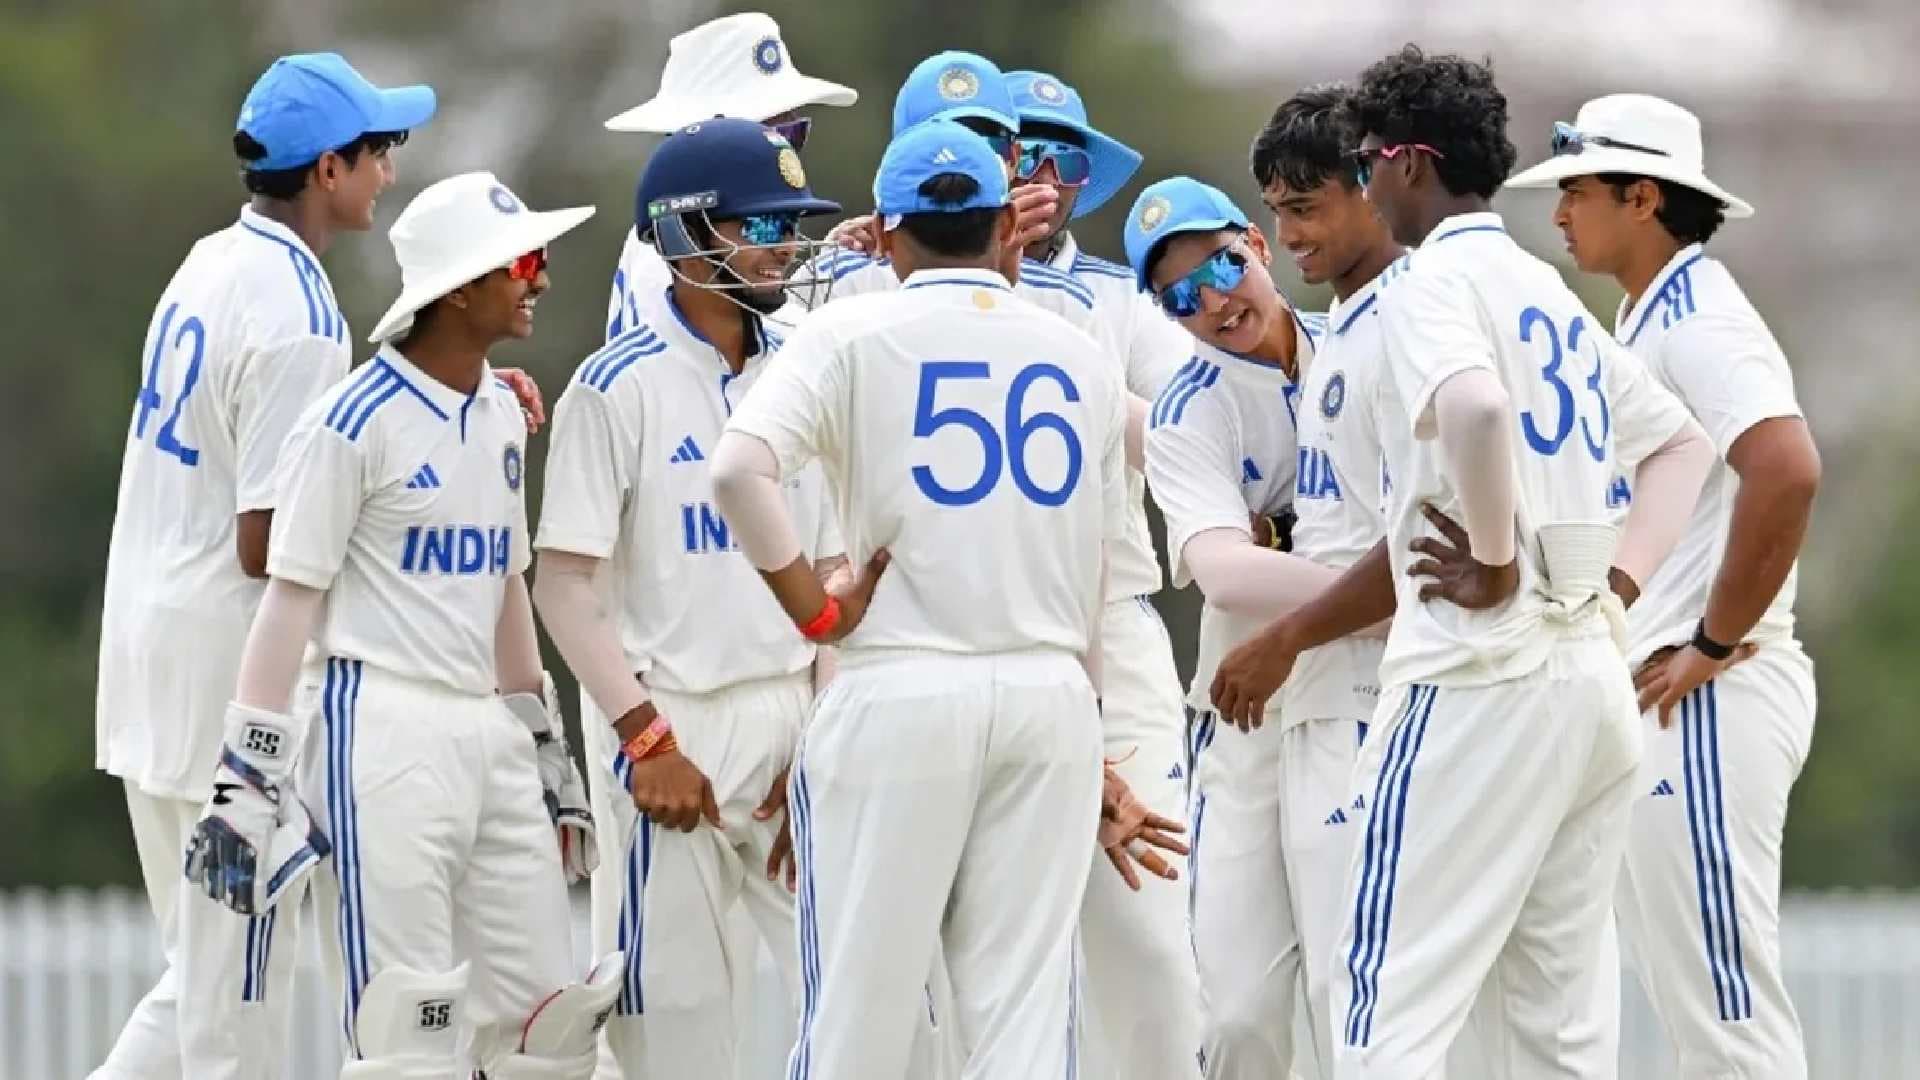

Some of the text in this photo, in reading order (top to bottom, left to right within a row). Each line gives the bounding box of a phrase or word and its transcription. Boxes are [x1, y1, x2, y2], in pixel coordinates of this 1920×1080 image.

[137, 303, 205, 466] 42
[1519, 306, 1609, 462] 33
[911, 361, 1082, 507] 56
[401, 526, 512, 574] INDIA
[682, 504, 738, 553] IN
[246, 728, 280, 755] SS
[421, 1004, 451, 1028] SS
